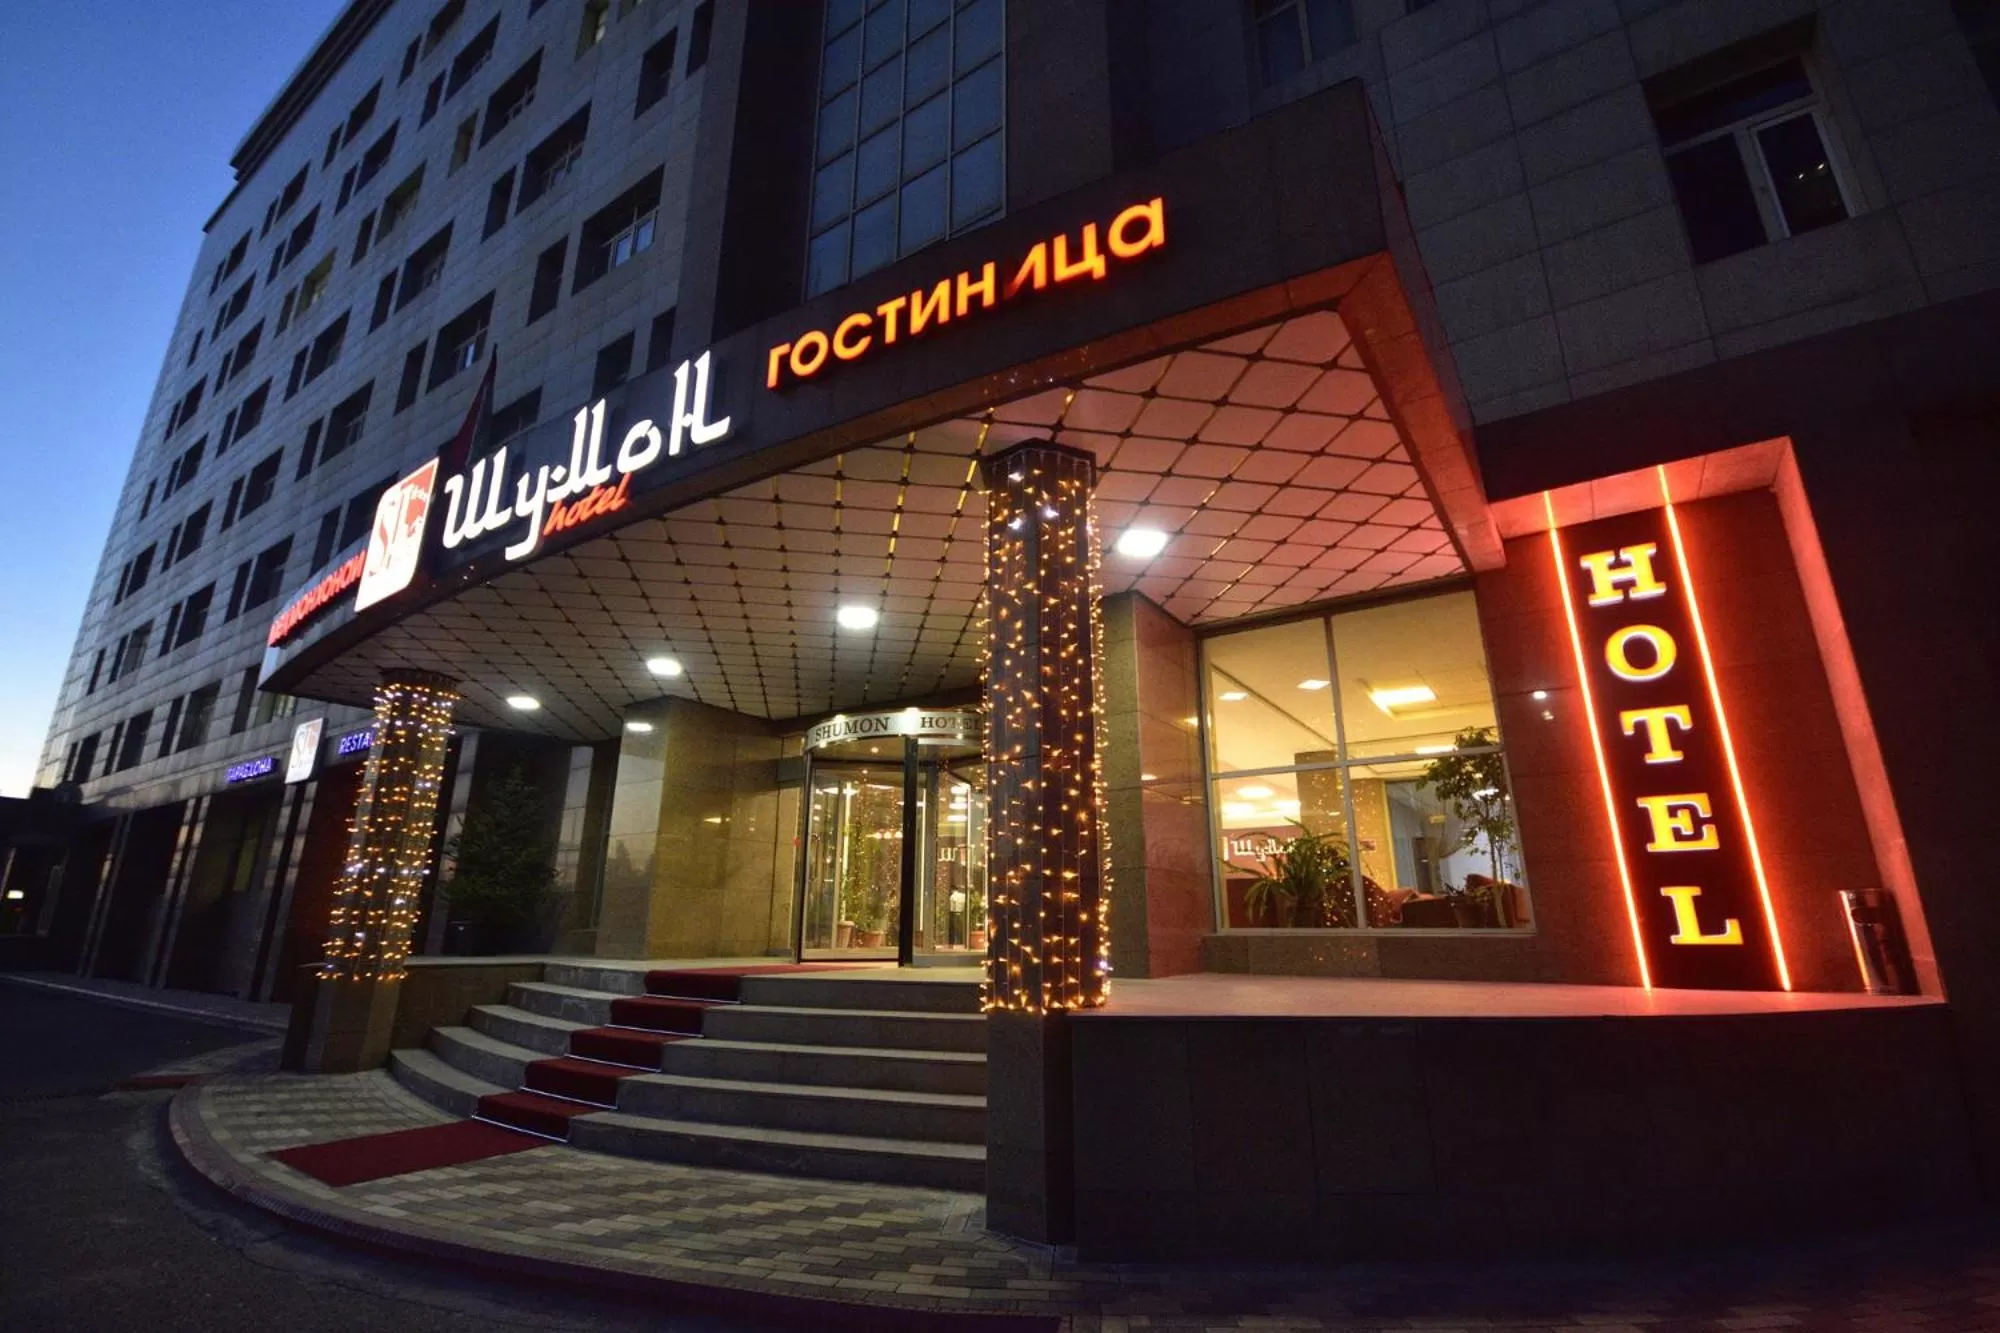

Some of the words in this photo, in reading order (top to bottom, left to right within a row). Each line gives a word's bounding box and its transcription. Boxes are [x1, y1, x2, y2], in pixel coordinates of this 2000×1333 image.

[543, 473, 632, 537] hotel
[815, 716, 890, 742] SHUMON
[1580, 542, 1744, 945] HOTEL
